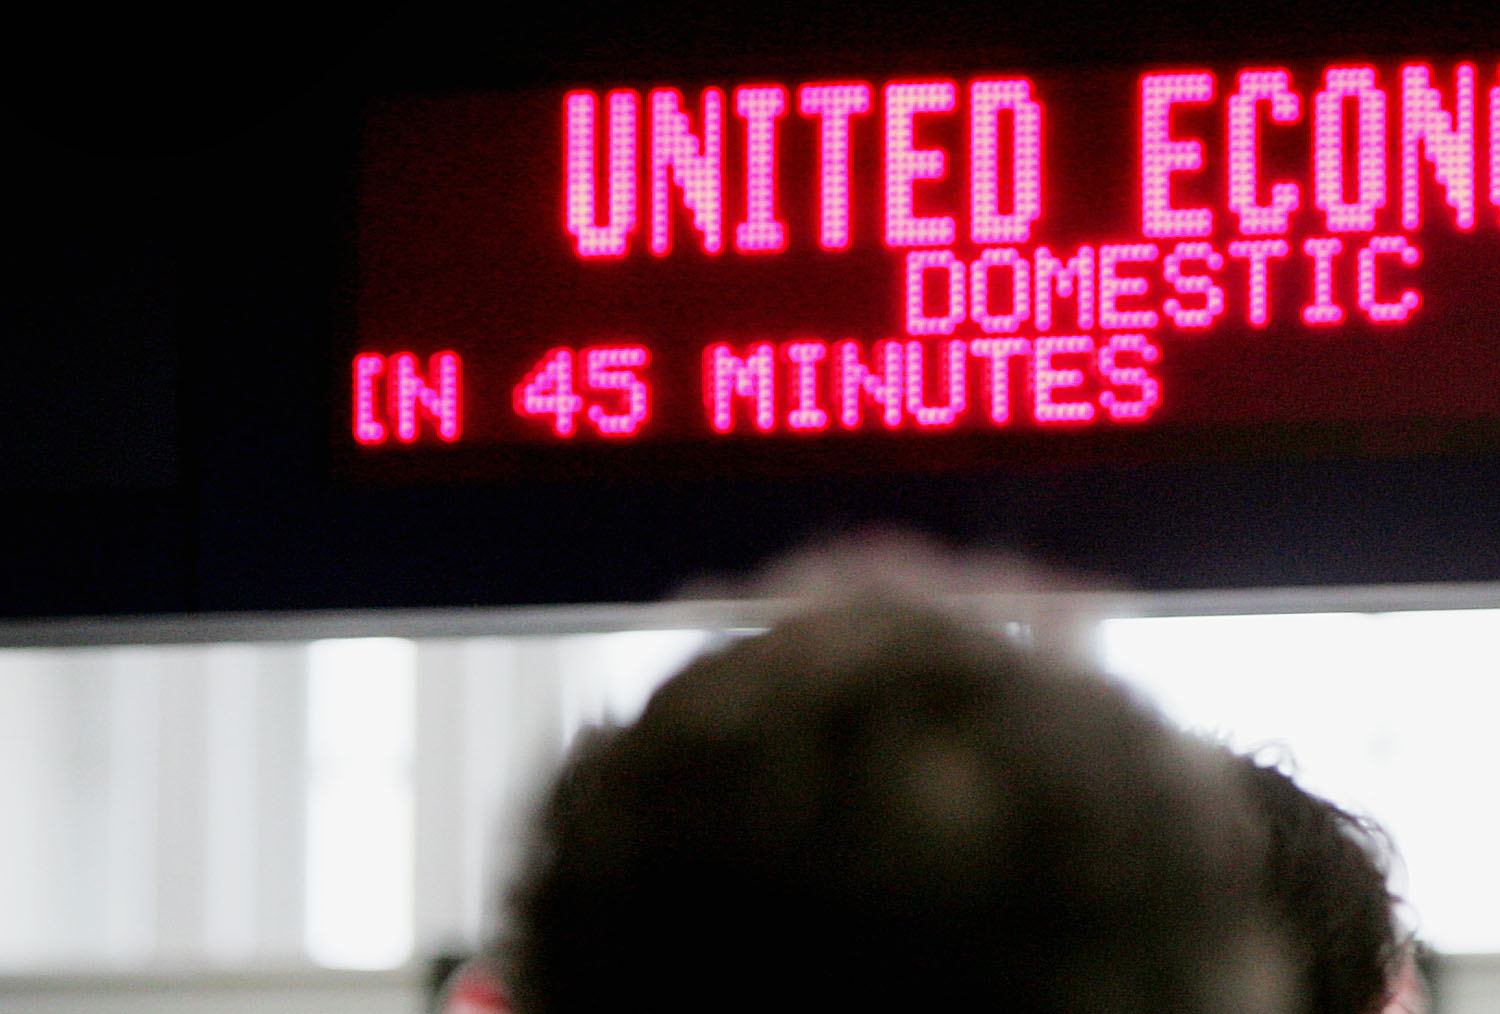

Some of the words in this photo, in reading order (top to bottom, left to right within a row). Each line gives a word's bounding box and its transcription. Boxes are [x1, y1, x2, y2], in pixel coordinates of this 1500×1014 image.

[563, 78, 1043, 258] UNITED
[904, 235, 1423, 336] DOMESTIC
[517, 346, 650, 437] 45
[706, 333, 1161, 433] MINUTES
